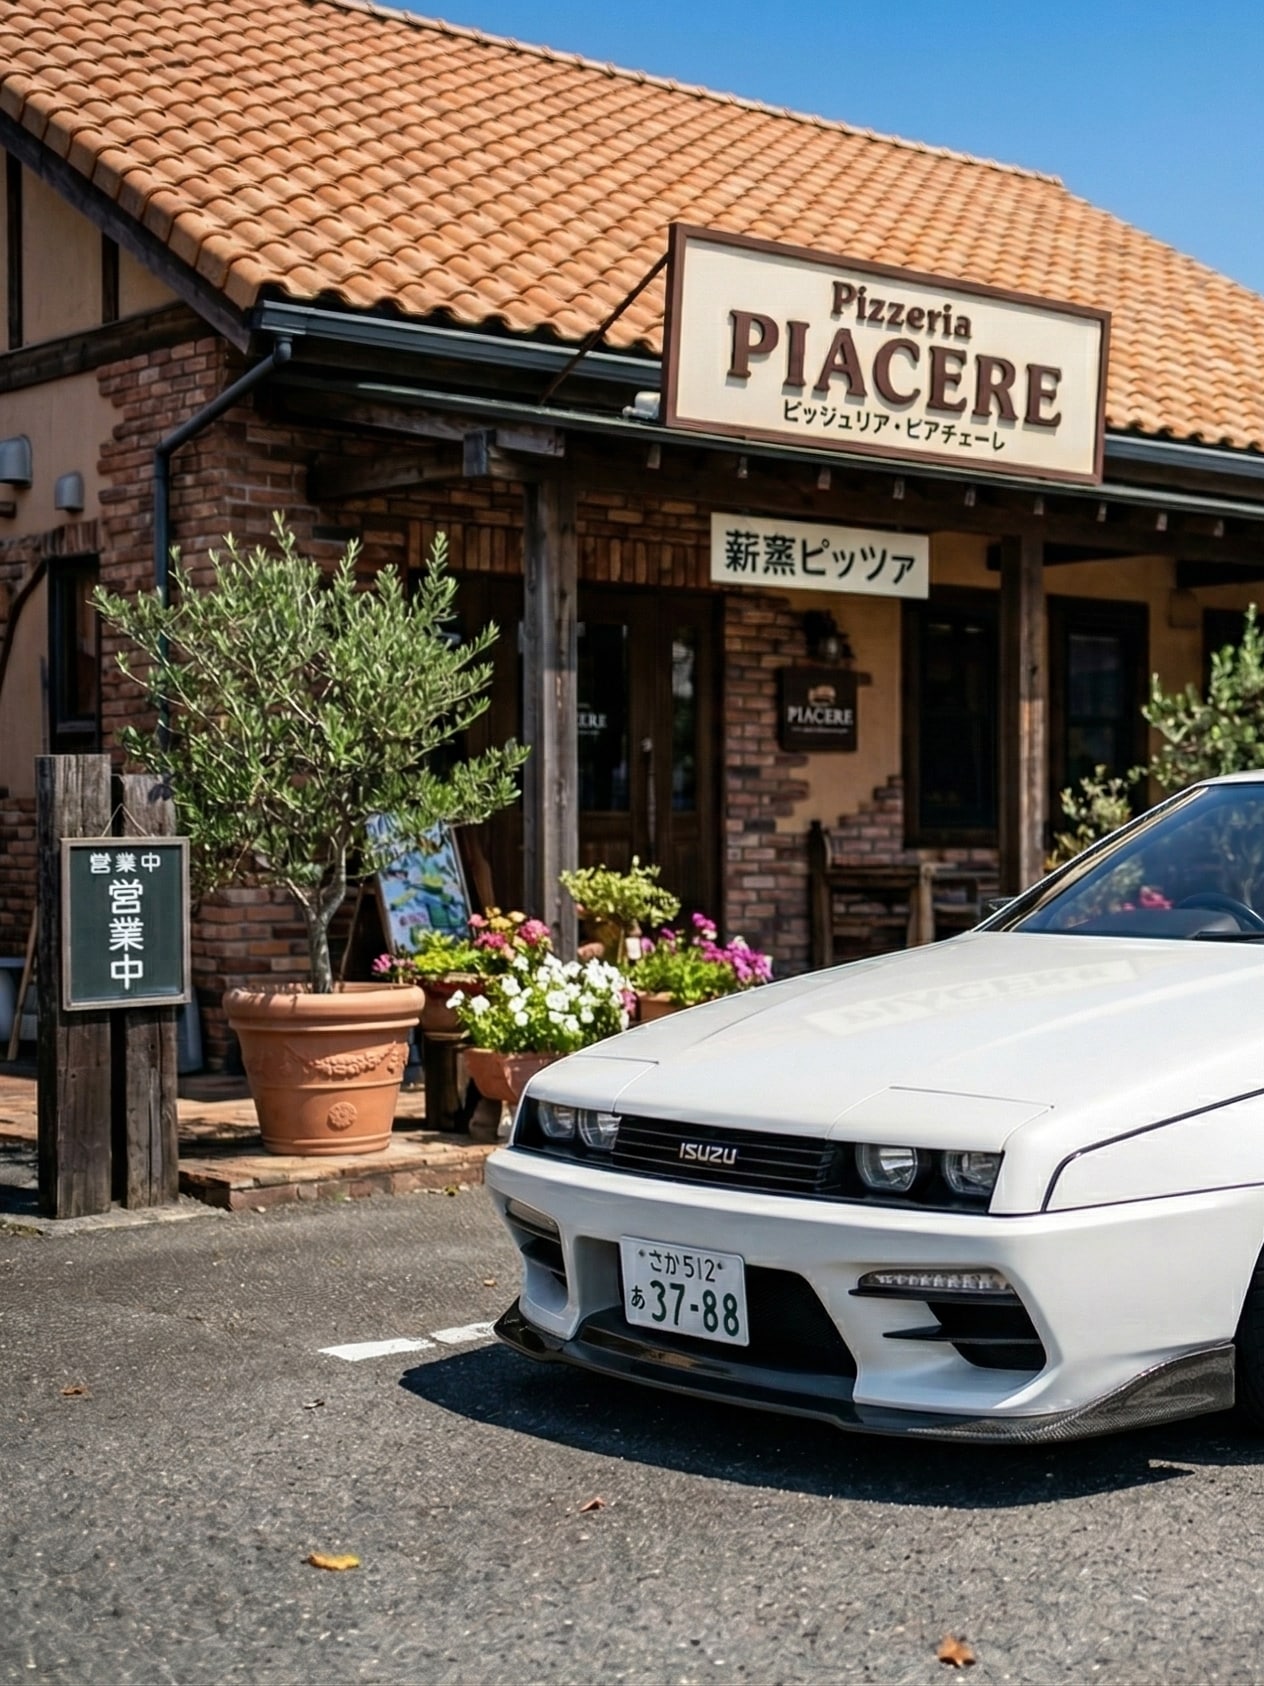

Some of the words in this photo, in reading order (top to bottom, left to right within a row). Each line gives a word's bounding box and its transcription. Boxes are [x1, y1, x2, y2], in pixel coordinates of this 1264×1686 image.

[831, 280, 972, 340] Pizzeria
[728, 309, 1062, 428] PIACERE
[787, 706, 854, 725] PIACERE
[90, 852, 161, 874] 営業中
[109, 878, 144, 990] 営業中
[679, 1142, 737, 1165] ISUZU
